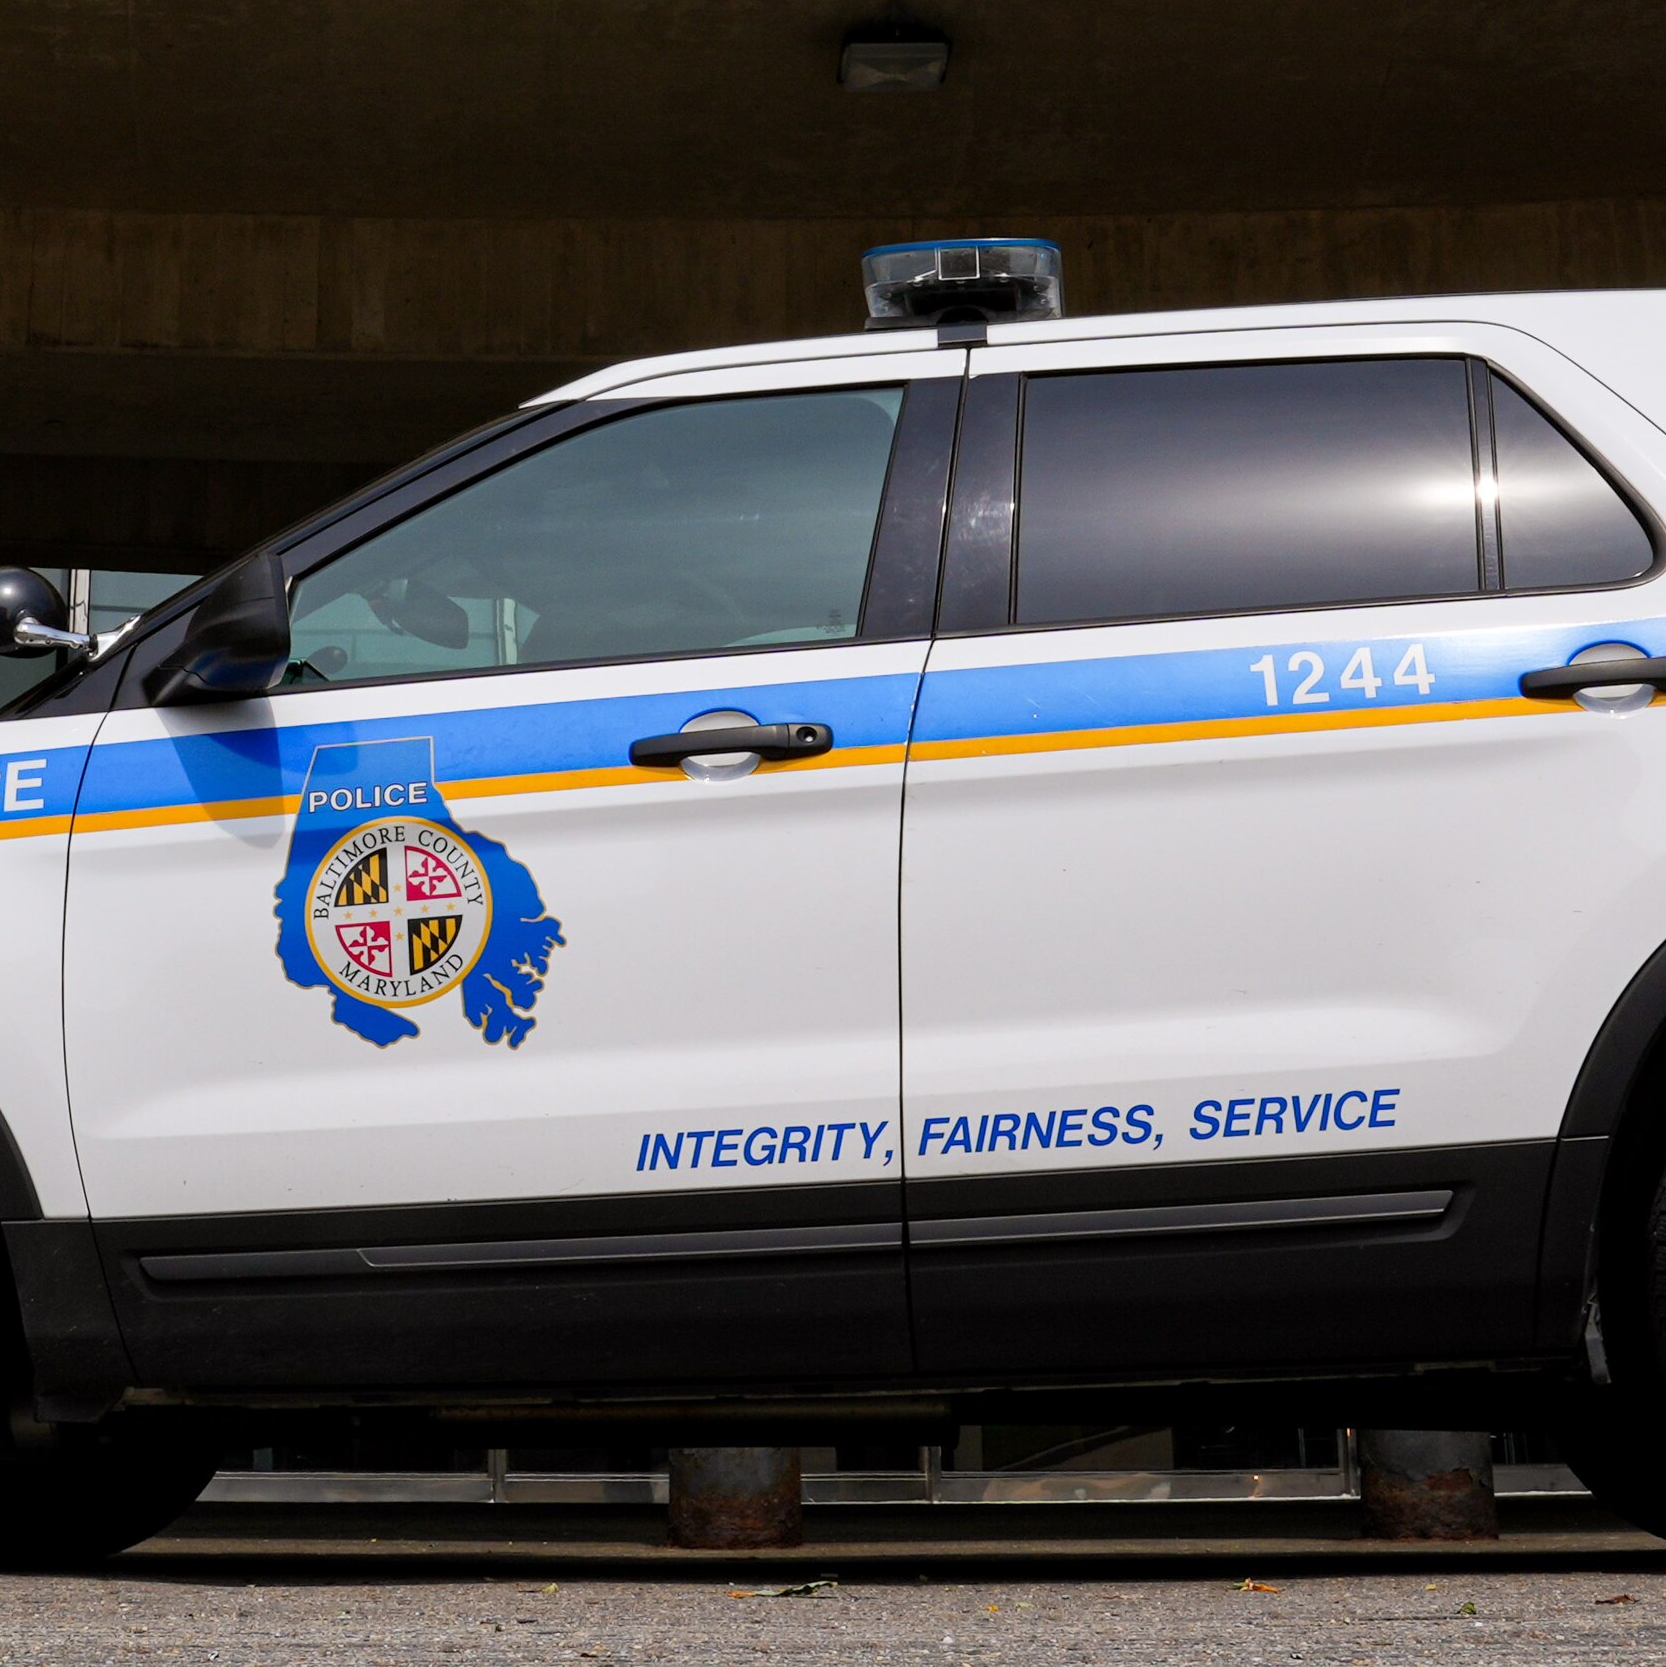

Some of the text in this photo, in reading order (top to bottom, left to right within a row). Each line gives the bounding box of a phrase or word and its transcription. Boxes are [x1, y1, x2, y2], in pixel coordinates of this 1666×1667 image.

[1249, 643, 1436, 707] 1244
[308, 782, 428, 813] POLICE
[313, 825, 484, 920] BALTIMORE COUNTY
[339, 953, 464, 998] MARYLAND
[636, 1088, 1401, 1172] INTEGRITY, FAIRNESS, SERVICE
